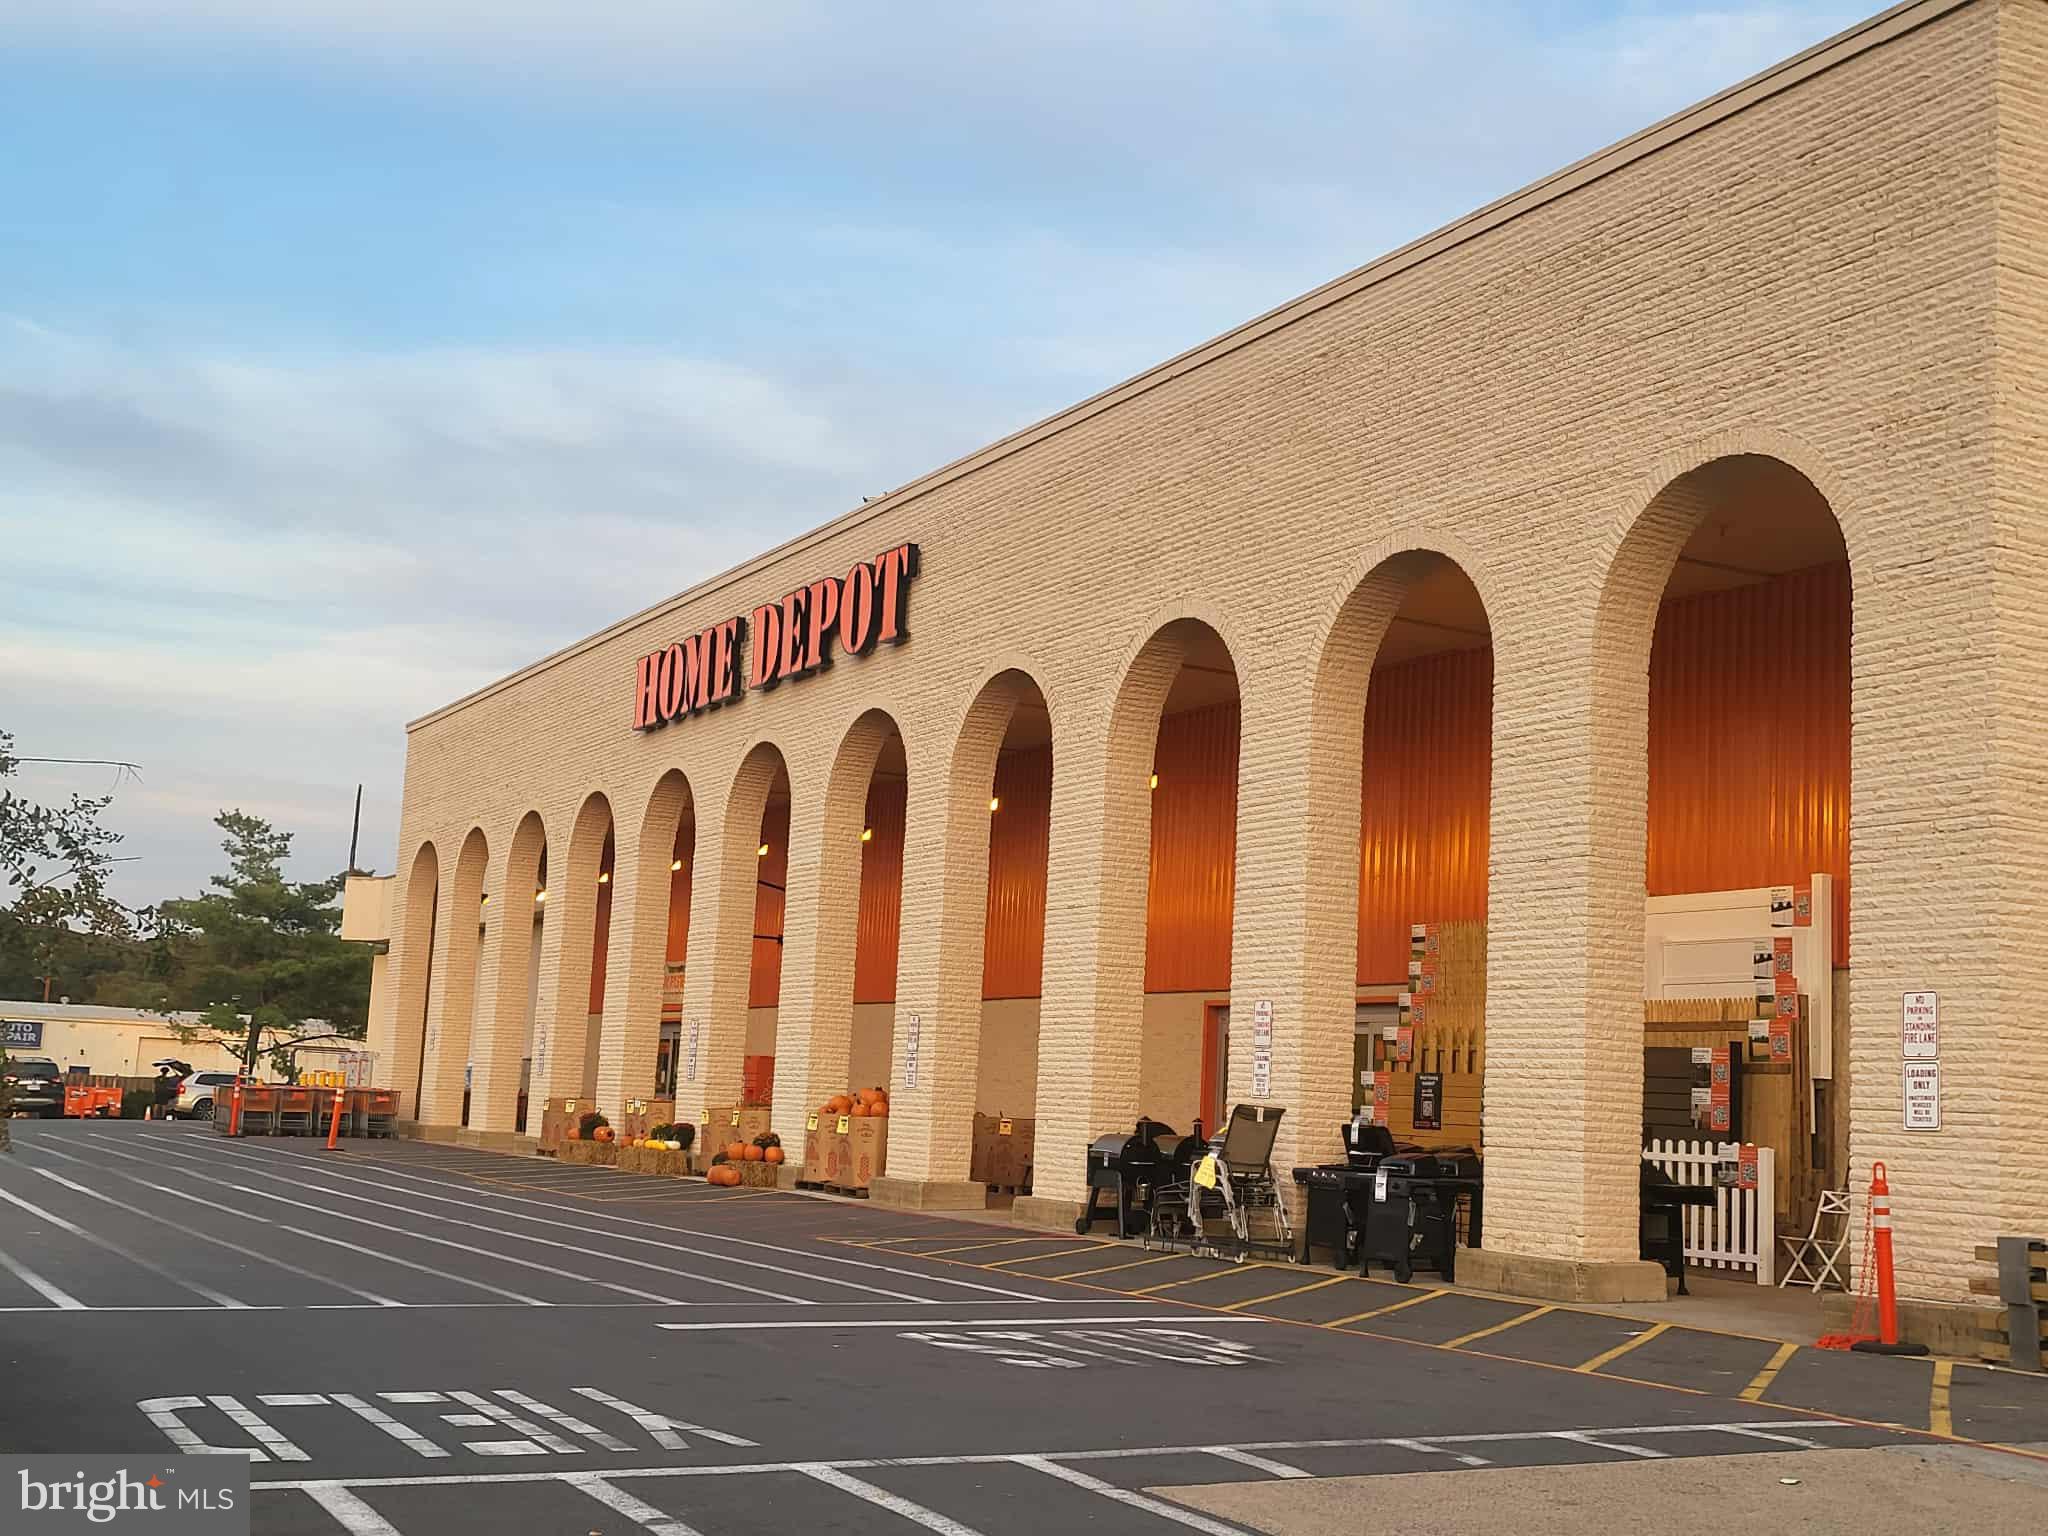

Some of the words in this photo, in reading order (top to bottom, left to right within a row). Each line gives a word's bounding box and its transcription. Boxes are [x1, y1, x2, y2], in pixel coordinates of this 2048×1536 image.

[632, 616, 747, 732] HOME
[750, 543, 919, 690] DEPOT
[1906, 1006, 1934, 1015] PARKING
[0, 1023, 33, 1032] UTO
[1905, 1022, 1935, 1031] STANDING
[0, 1032, 37, 1042] PAIR
[1904, 1032, 1918, 1043] FIRE
[1919, 1032, 1935, 1043] LANE
[1907, 1068, 1937, 1078] LOADING
[1913, 1080, 1930, 1090] ONLY
[136, 1386, 762, 1463] YIELD
